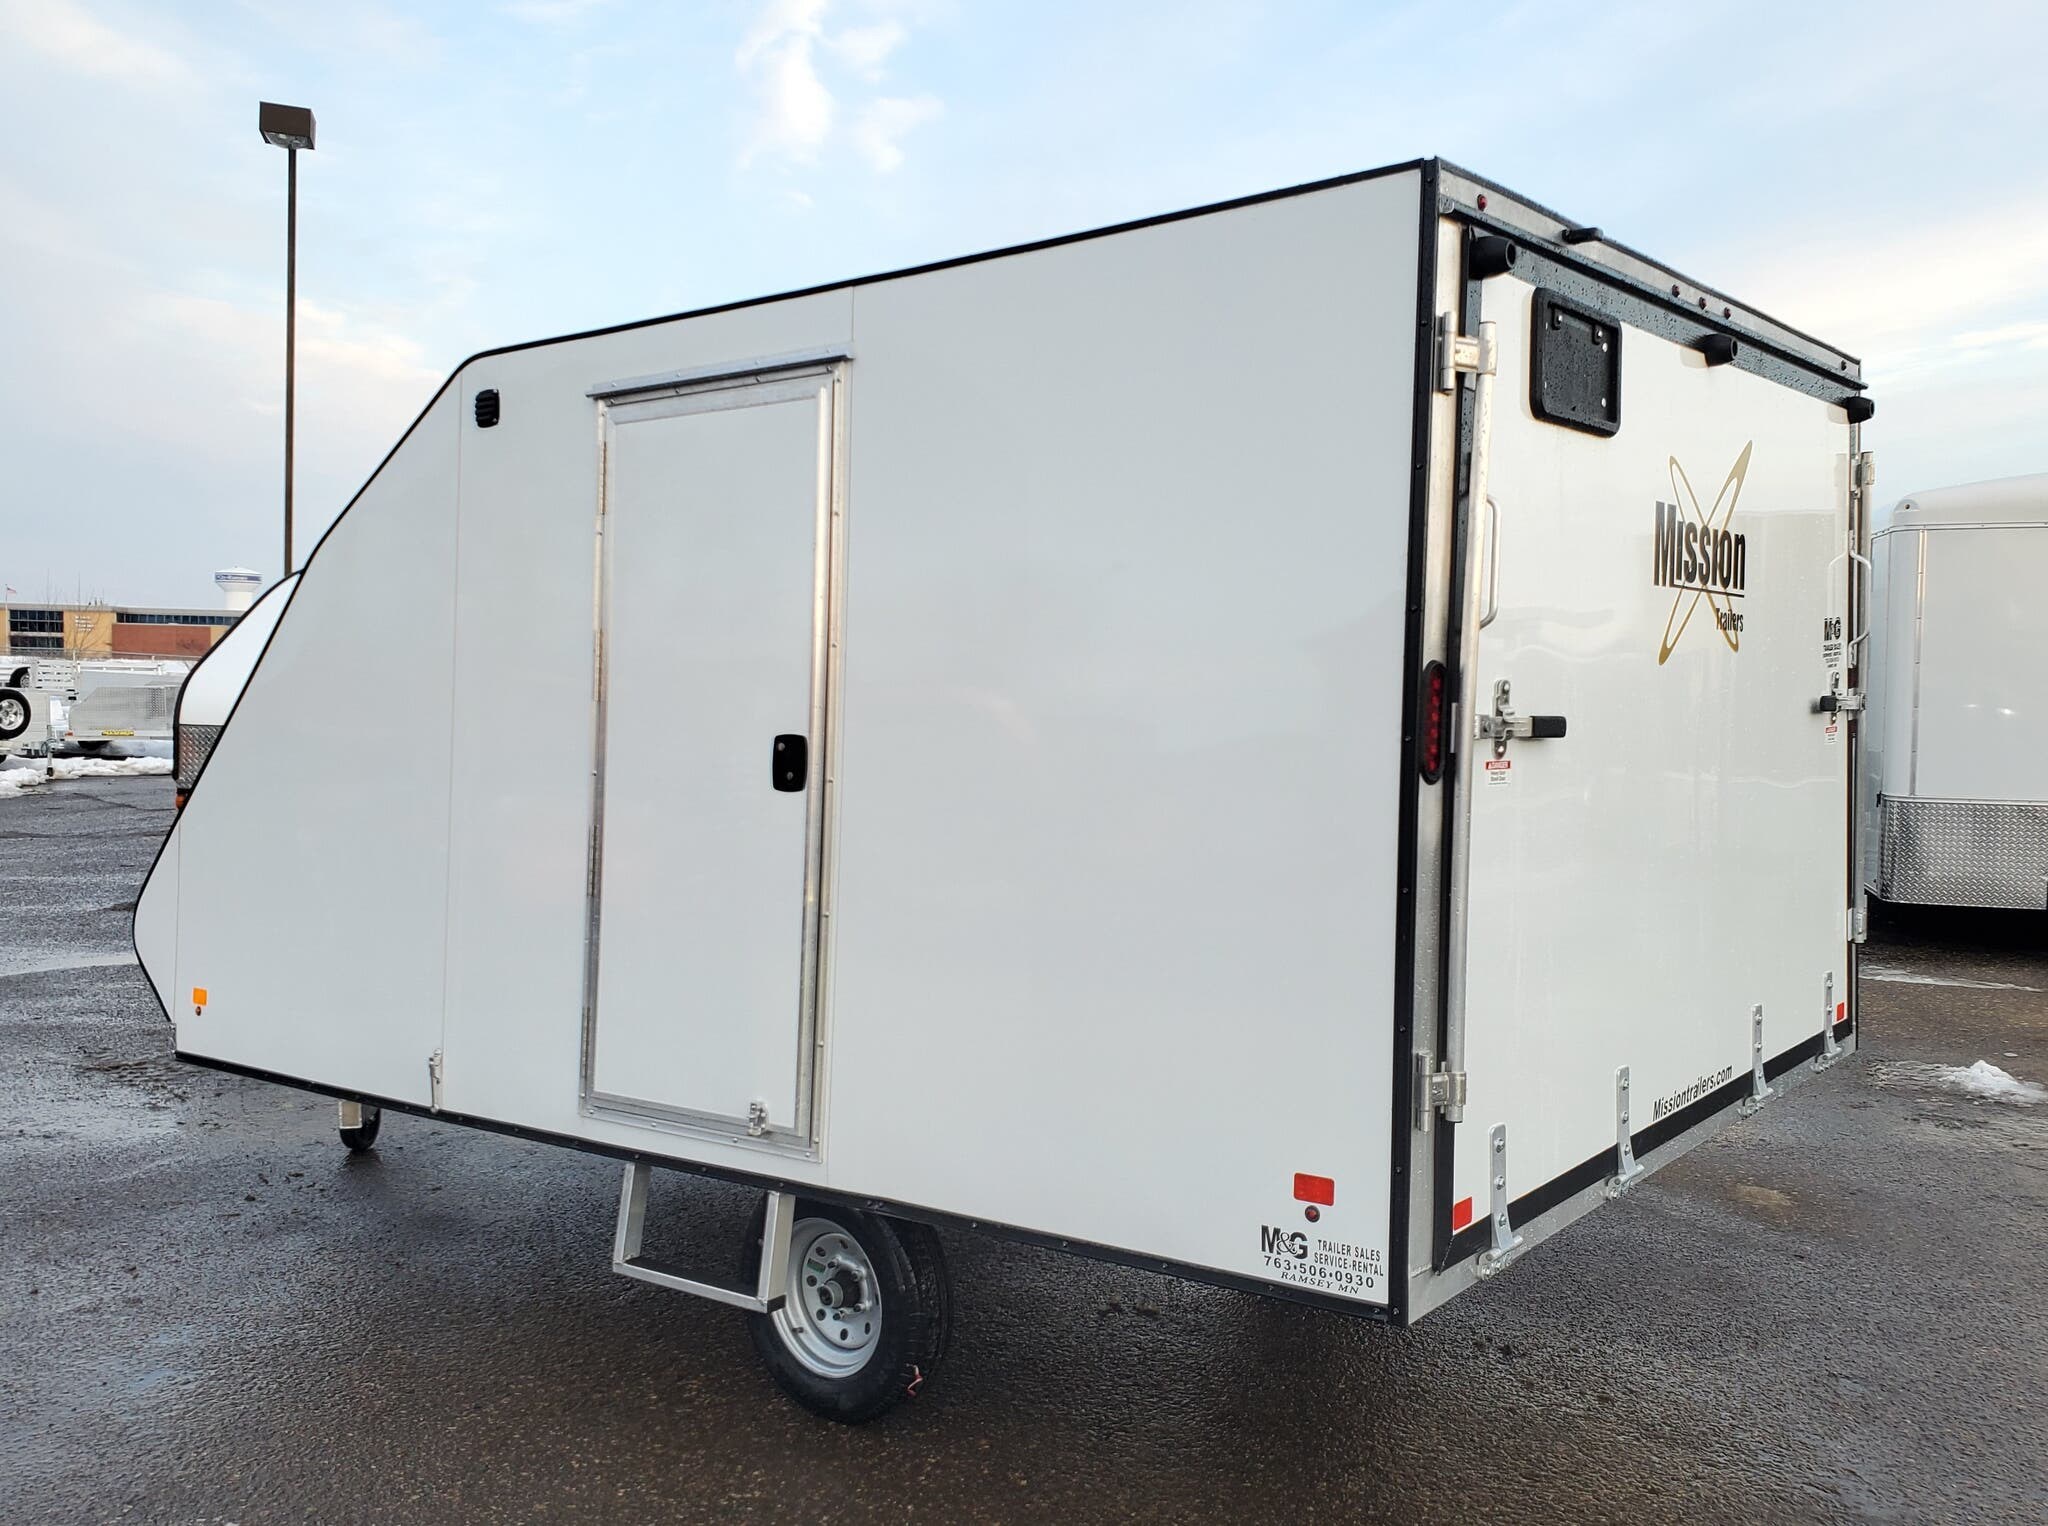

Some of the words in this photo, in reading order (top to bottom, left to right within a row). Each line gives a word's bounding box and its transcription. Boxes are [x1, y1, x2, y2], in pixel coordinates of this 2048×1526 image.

[1654, 501, 1745, 590] Mission
[1715, 608, 1744, 632] Trailers
[1653, 1065, 1733, 1122] Missiontrailers.com
[1261, 1225, 1309, 1259] M&G
[1317, 1239, 1352, 1257] TRAILER
[1354, 1246, 1381, 1262] SALES
[1281, 1271, 1334, 1289] RAMSEY
[1338, 1284, 1360, 1294] MN
